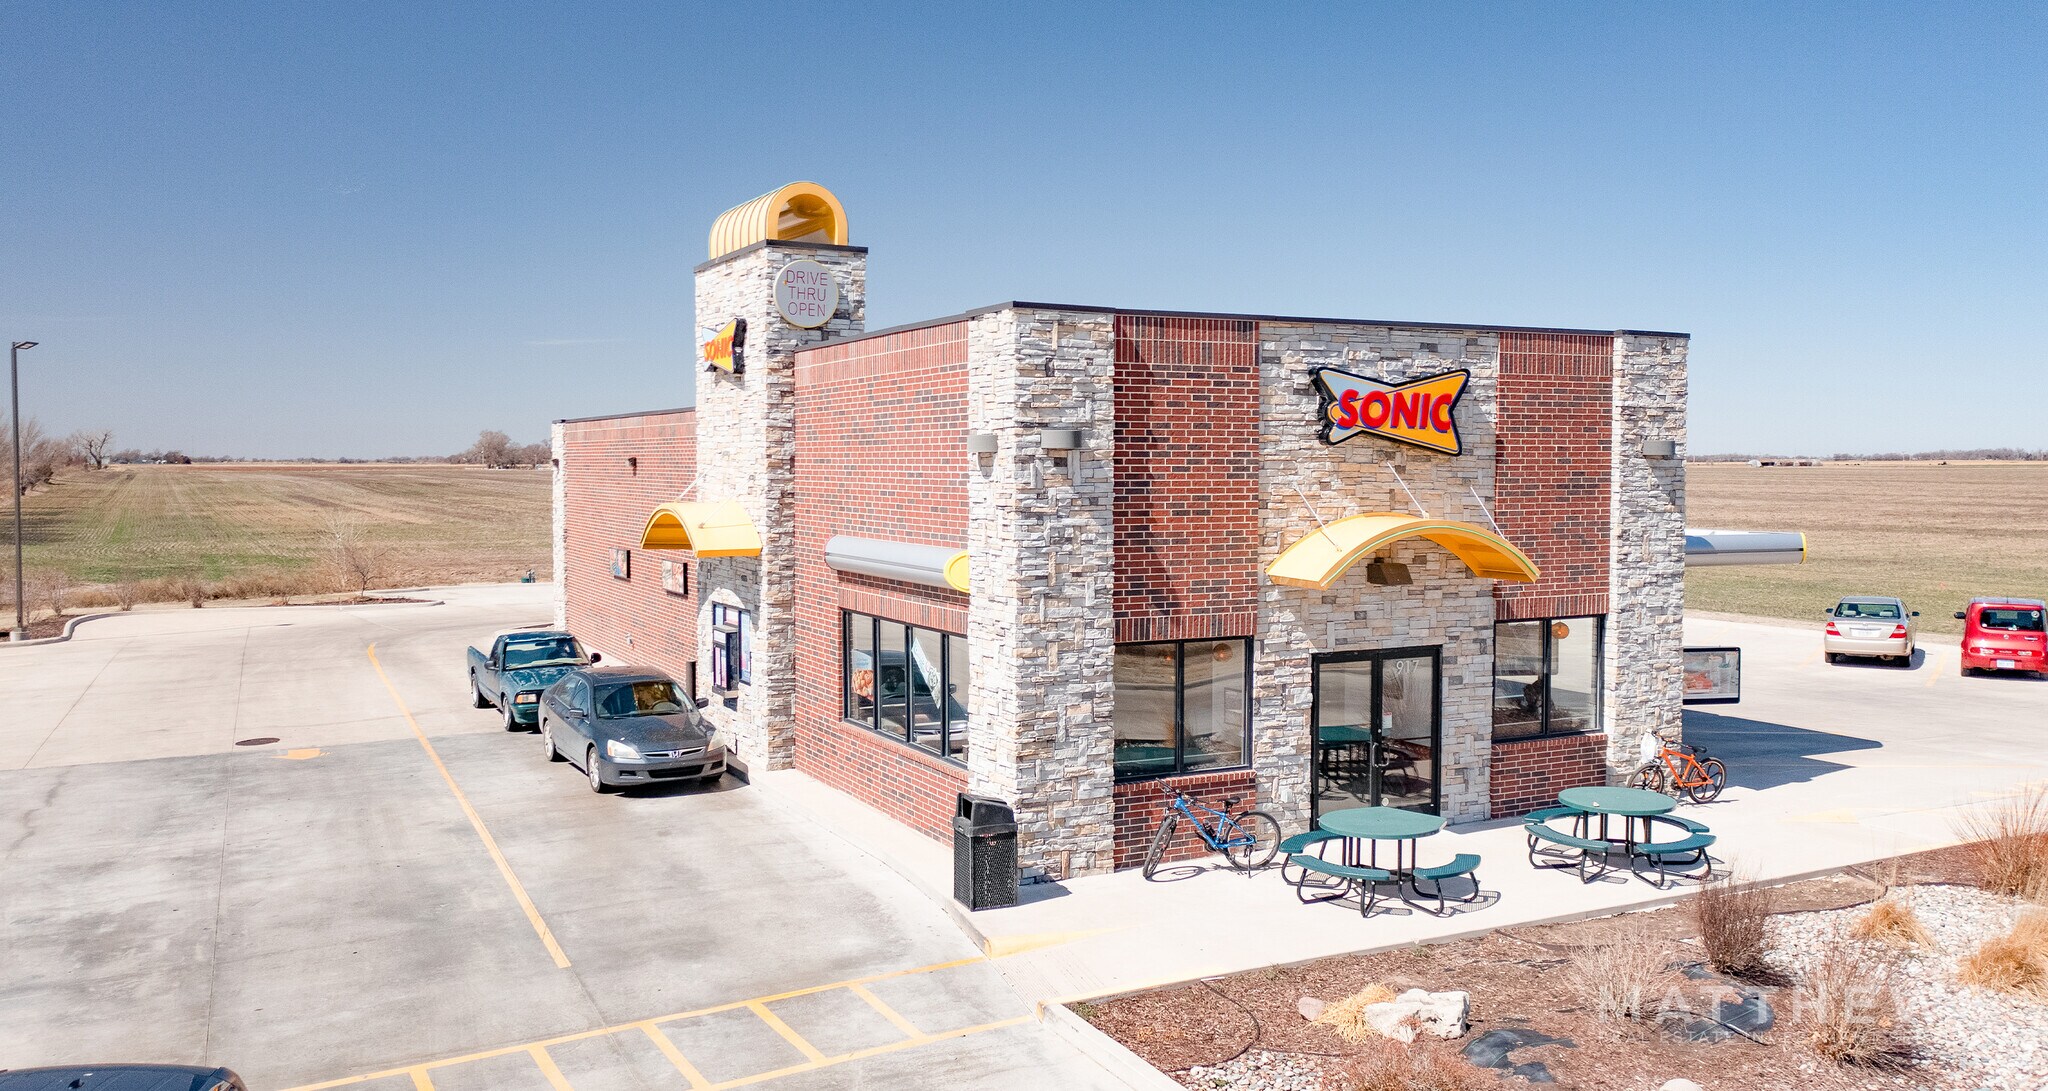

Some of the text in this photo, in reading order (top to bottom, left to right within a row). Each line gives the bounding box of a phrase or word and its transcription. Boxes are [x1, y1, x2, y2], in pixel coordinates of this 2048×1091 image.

[786, 270, 828, 286] DRIVE
[788, 286, 827, 302] THRU
[787, 302, 826, 317] OPEN
[704, 335, 735, 362] SONIC
[1335, 388, 1453, 434] SONIC
[1396, 660, 1420, 675] 917
